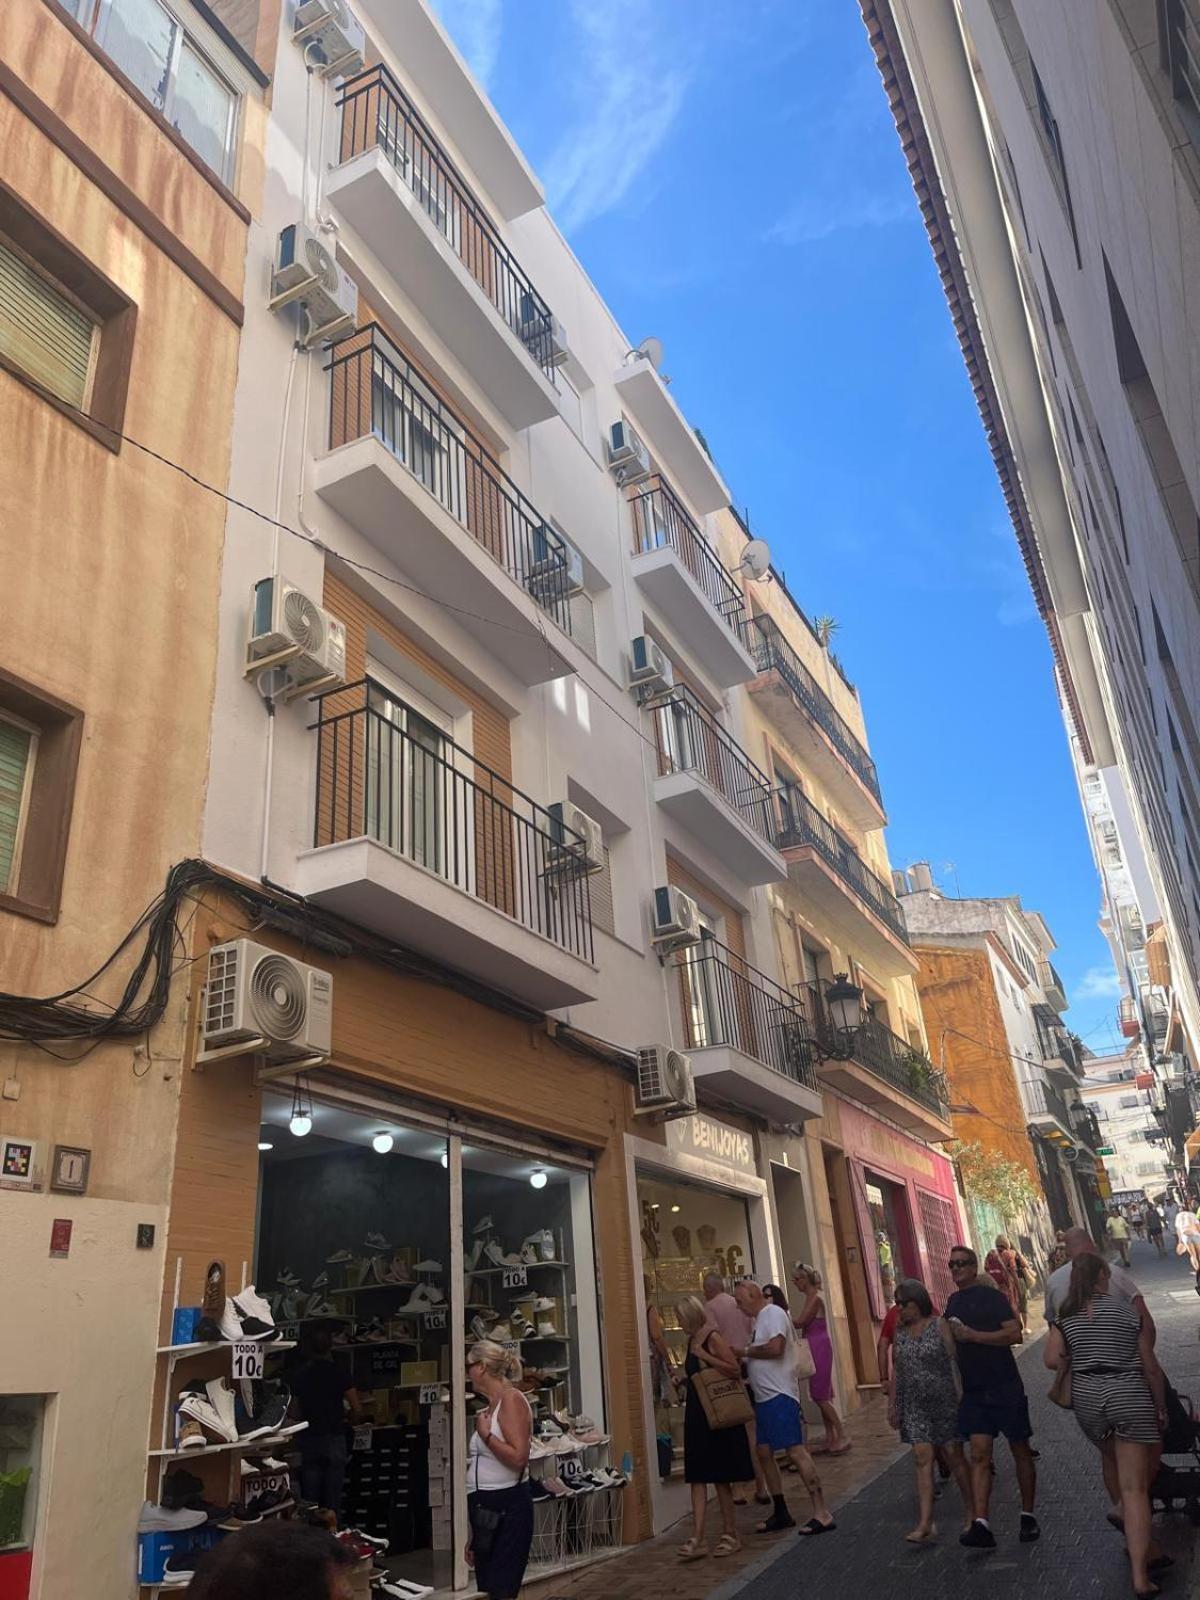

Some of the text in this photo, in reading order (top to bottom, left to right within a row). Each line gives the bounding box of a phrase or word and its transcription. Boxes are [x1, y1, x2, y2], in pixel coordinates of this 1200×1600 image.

[692, 1115, 749, 1166] BENIJOYAS
[234, 1344, 263, 1354] TODO A
[235, 1355, 262, 1377] 10€
